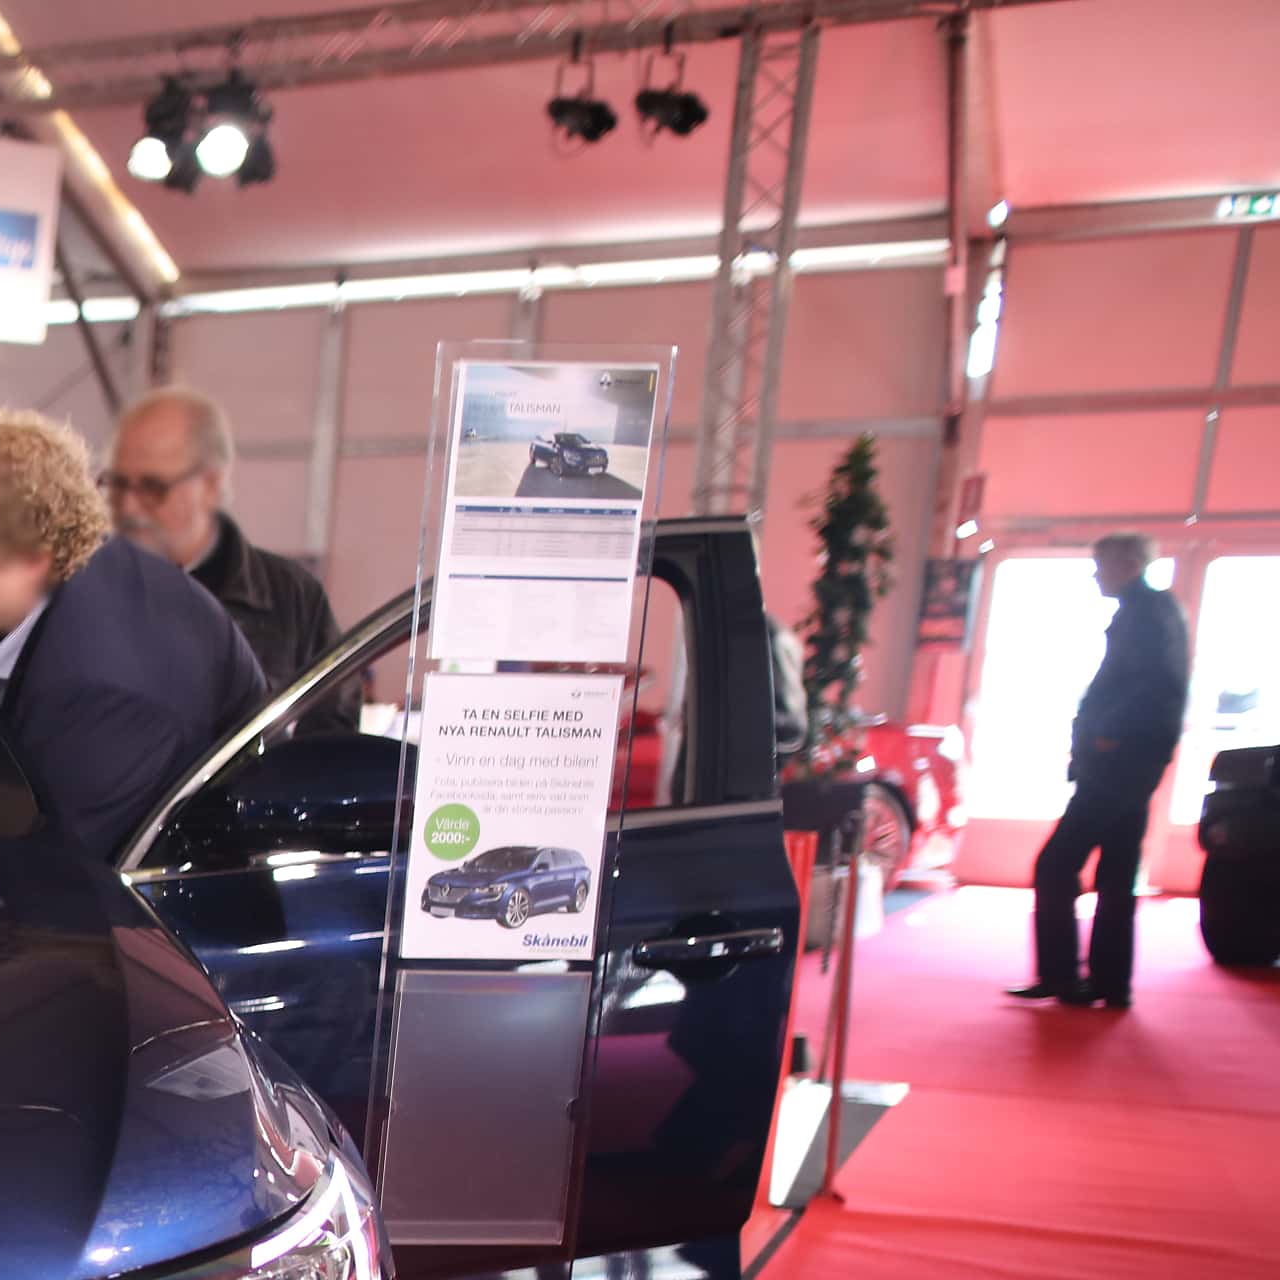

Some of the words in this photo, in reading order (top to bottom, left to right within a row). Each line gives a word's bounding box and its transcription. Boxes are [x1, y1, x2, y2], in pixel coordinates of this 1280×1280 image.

[508, 402, 561, 415] TALISMAN
[462, 708, 478, 721] TA
[481, 708, 500, 721] EN
[503, 709, 549, 722] SELFIE
[552, 710, 584, 721] MED
[439, 725, 466, 737] NYA
[469, 726, 530, 738] RENAULT
[535, 727, 602, 739] TALISMAN
[446, 752, 475, 767] Vinn
[479, 756, 496, 768] en
[500, 753, 525, 771] dag
[529, 754, 560, 769] med
[563, 754, 599, 769] bilen!
[435, 816, 470, 831] Värde
[431, 831, 470, 844] 2000:-
[522, 933, 589, 947] Skånebil
